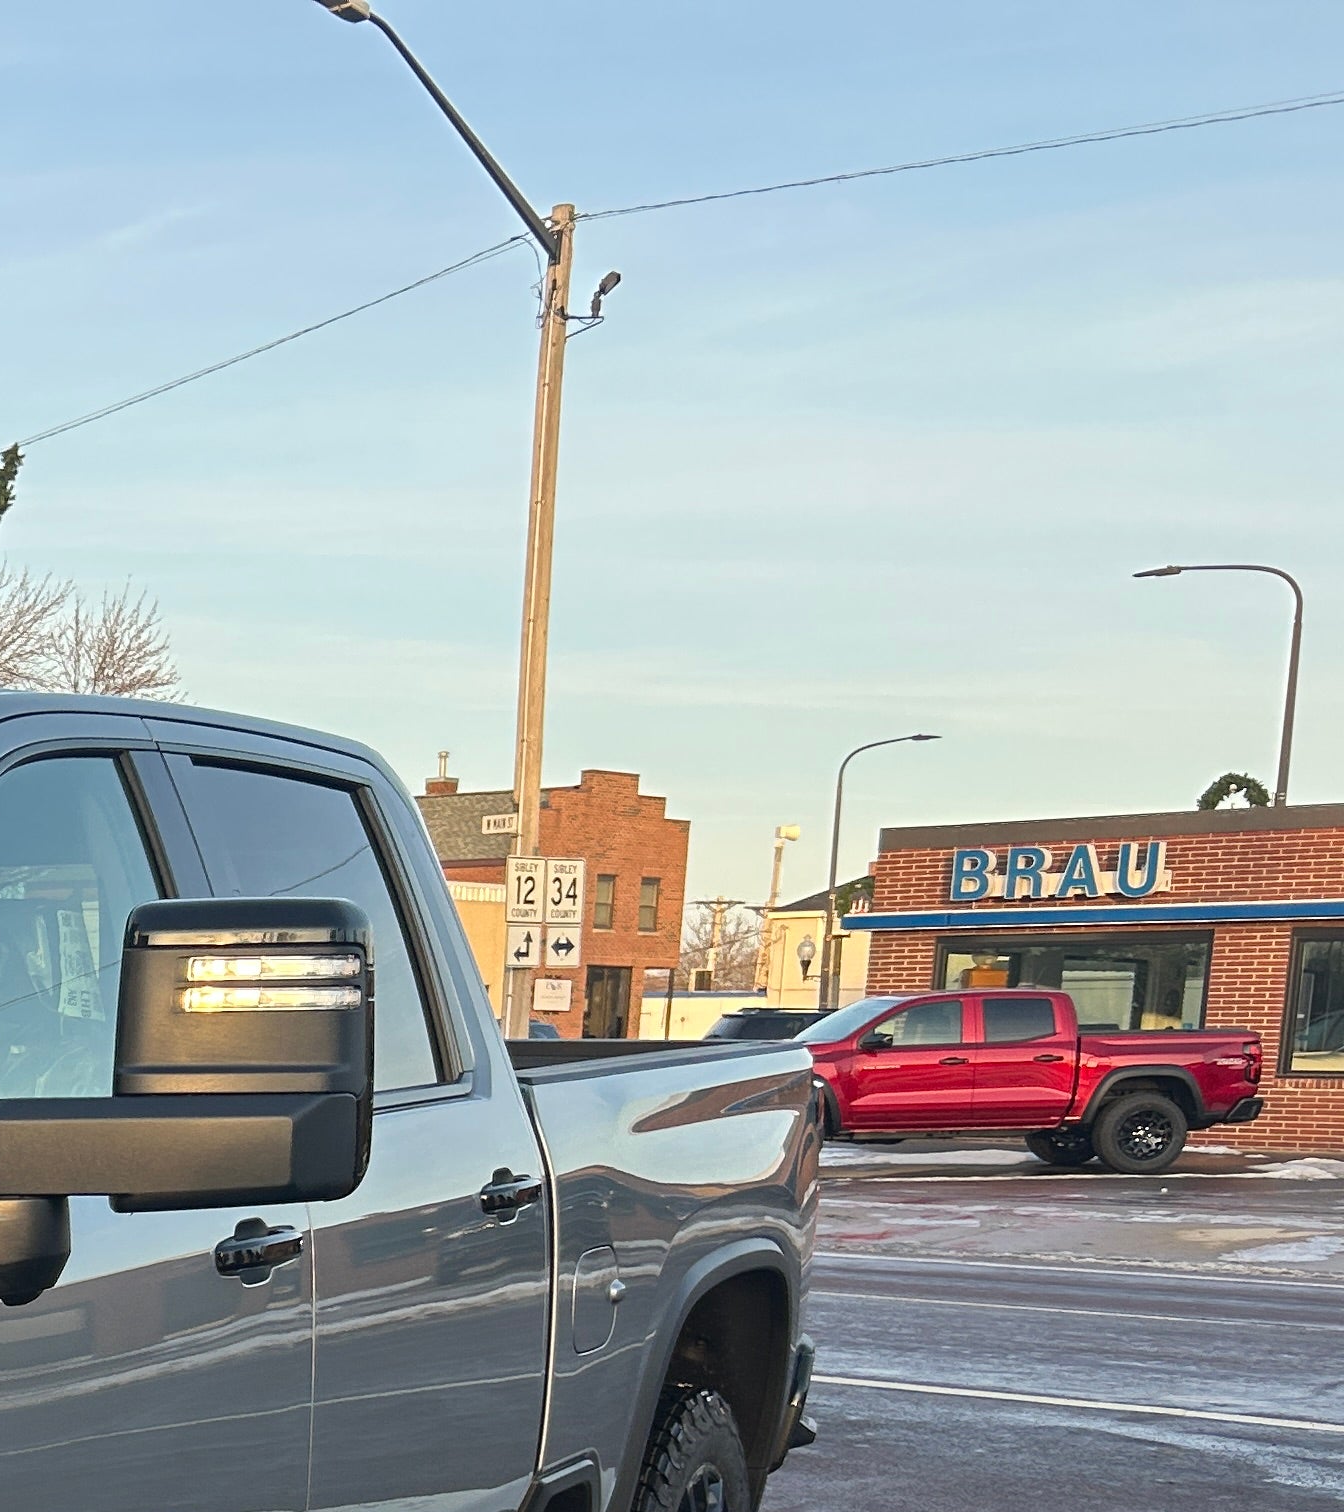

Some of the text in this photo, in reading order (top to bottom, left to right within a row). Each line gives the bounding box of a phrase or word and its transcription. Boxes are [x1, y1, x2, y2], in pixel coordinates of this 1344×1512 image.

[514, 862, 538, 872] SIBLEY
[553, 864, 577, 874] SIBLEY
[950, 841, 1168, 901] BRAU
[516, 875, 535, 905] 12
[551, 877, 577, 906] 34
[511, 908, 537, 918] COUNTY
[550, 909, 577, 919] COUNTY
